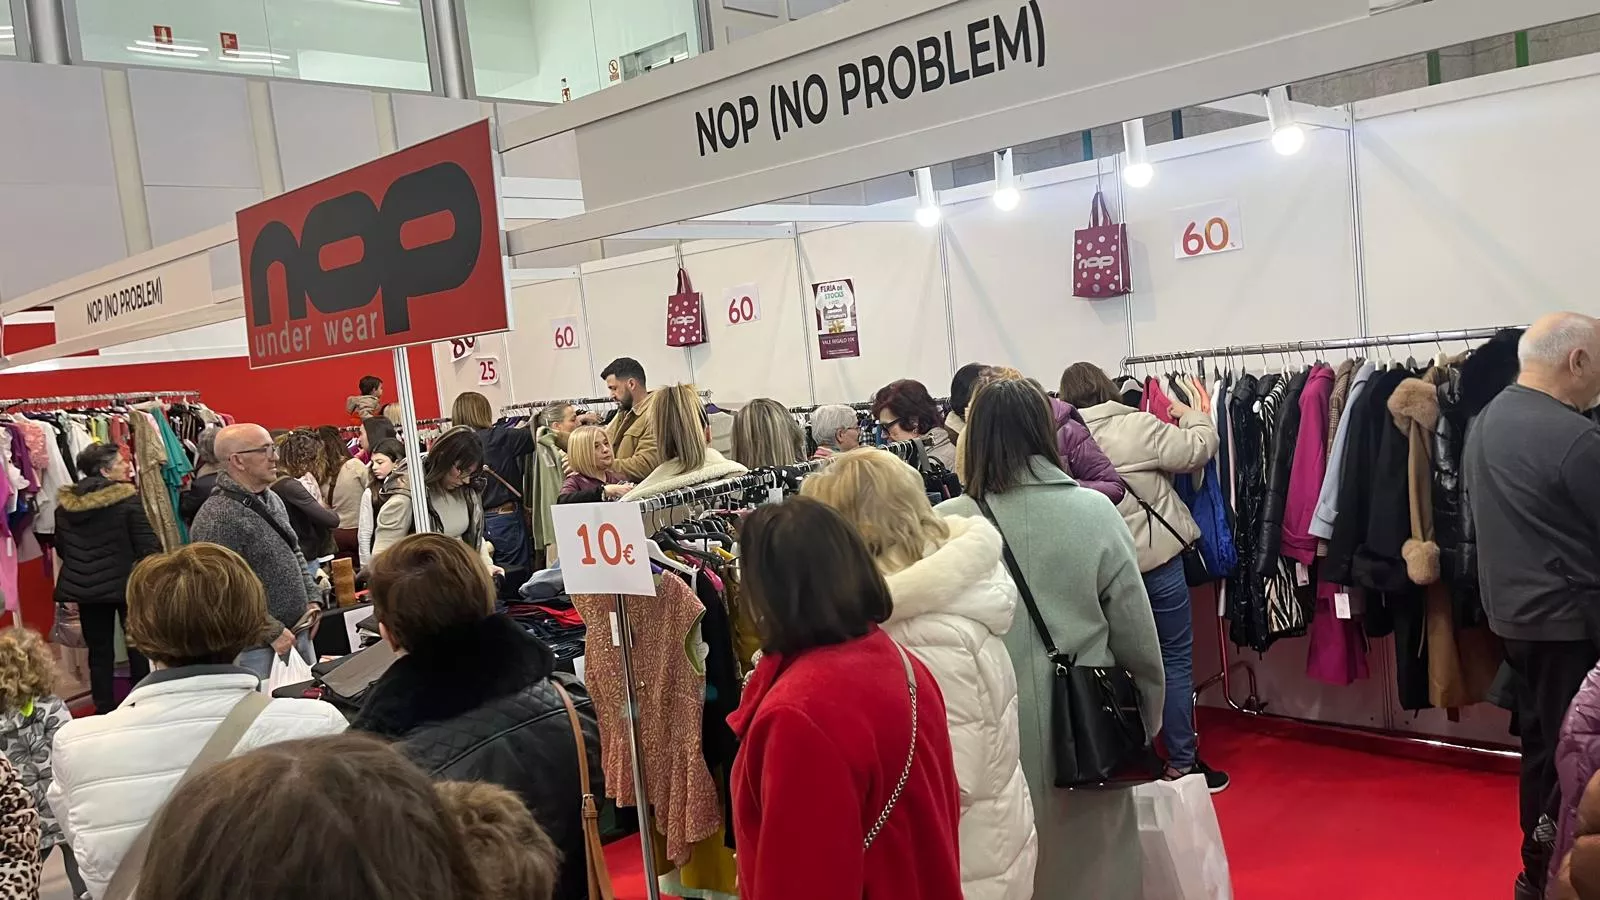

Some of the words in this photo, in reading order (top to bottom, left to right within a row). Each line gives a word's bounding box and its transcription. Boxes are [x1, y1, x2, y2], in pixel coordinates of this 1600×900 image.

[695, 96, 759, 156] NOP
[770, 74, 828, 141] (NO
[838, 0, 1045, 116] PROBLEM)
[250, 161, 483, 336] nop
[1078, 255, 1115, 269] nop
[86, 298, 103, 325] NOP
[104, 292, 119, 321] (NO
[120, 276, 163, 315] PROBLEM)
[825, 291, 844, 299] STOCKS
[255, 322, 312, 358] under
[323, 310, 378, 347] wear
[669, 315, 696, 326] nop
[479, 361, 496, 381] 25
[576, 522, 636, 566] 10€
